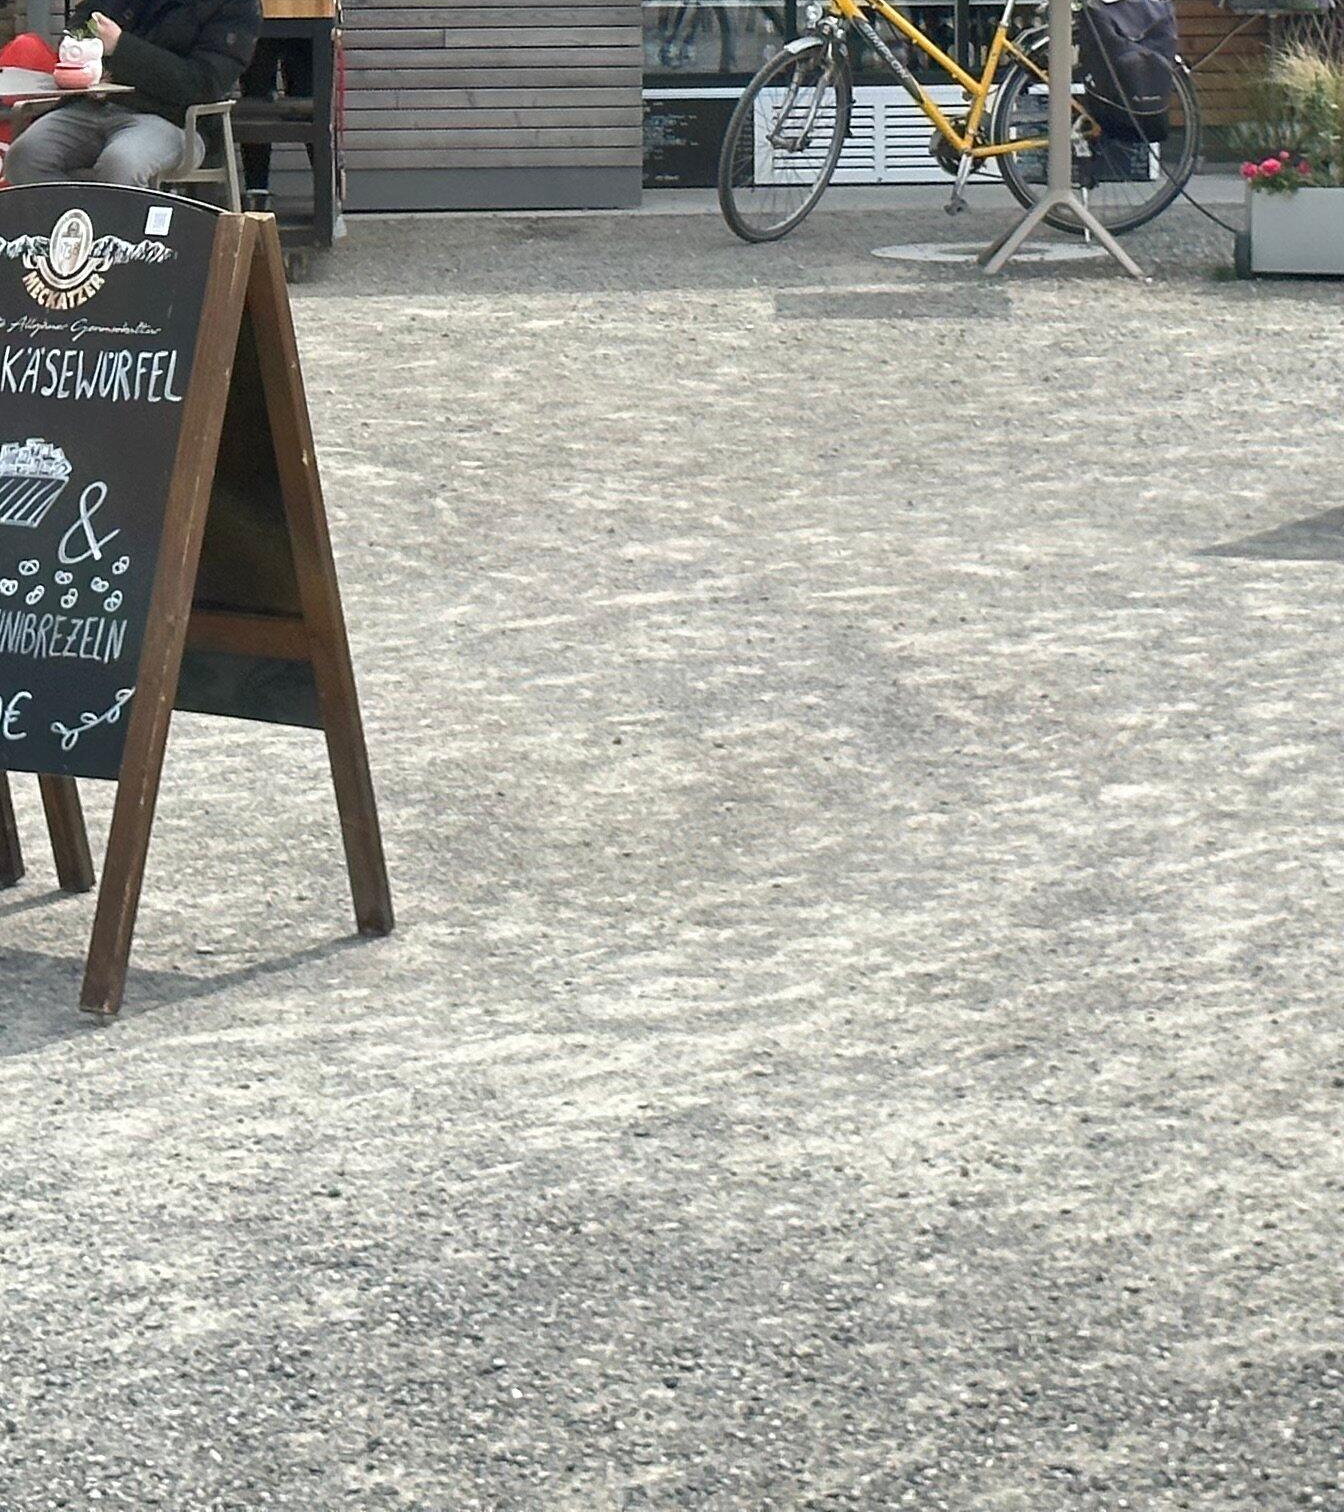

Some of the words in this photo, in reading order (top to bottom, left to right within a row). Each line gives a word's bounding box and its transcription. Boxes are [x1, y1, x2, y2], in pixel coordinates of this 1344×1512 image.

[22, 271, 105, 310] MECKATZER
[0, 345, 182, 402] KÄSEWÜRFEL
[58, 480, 121, 564] &
